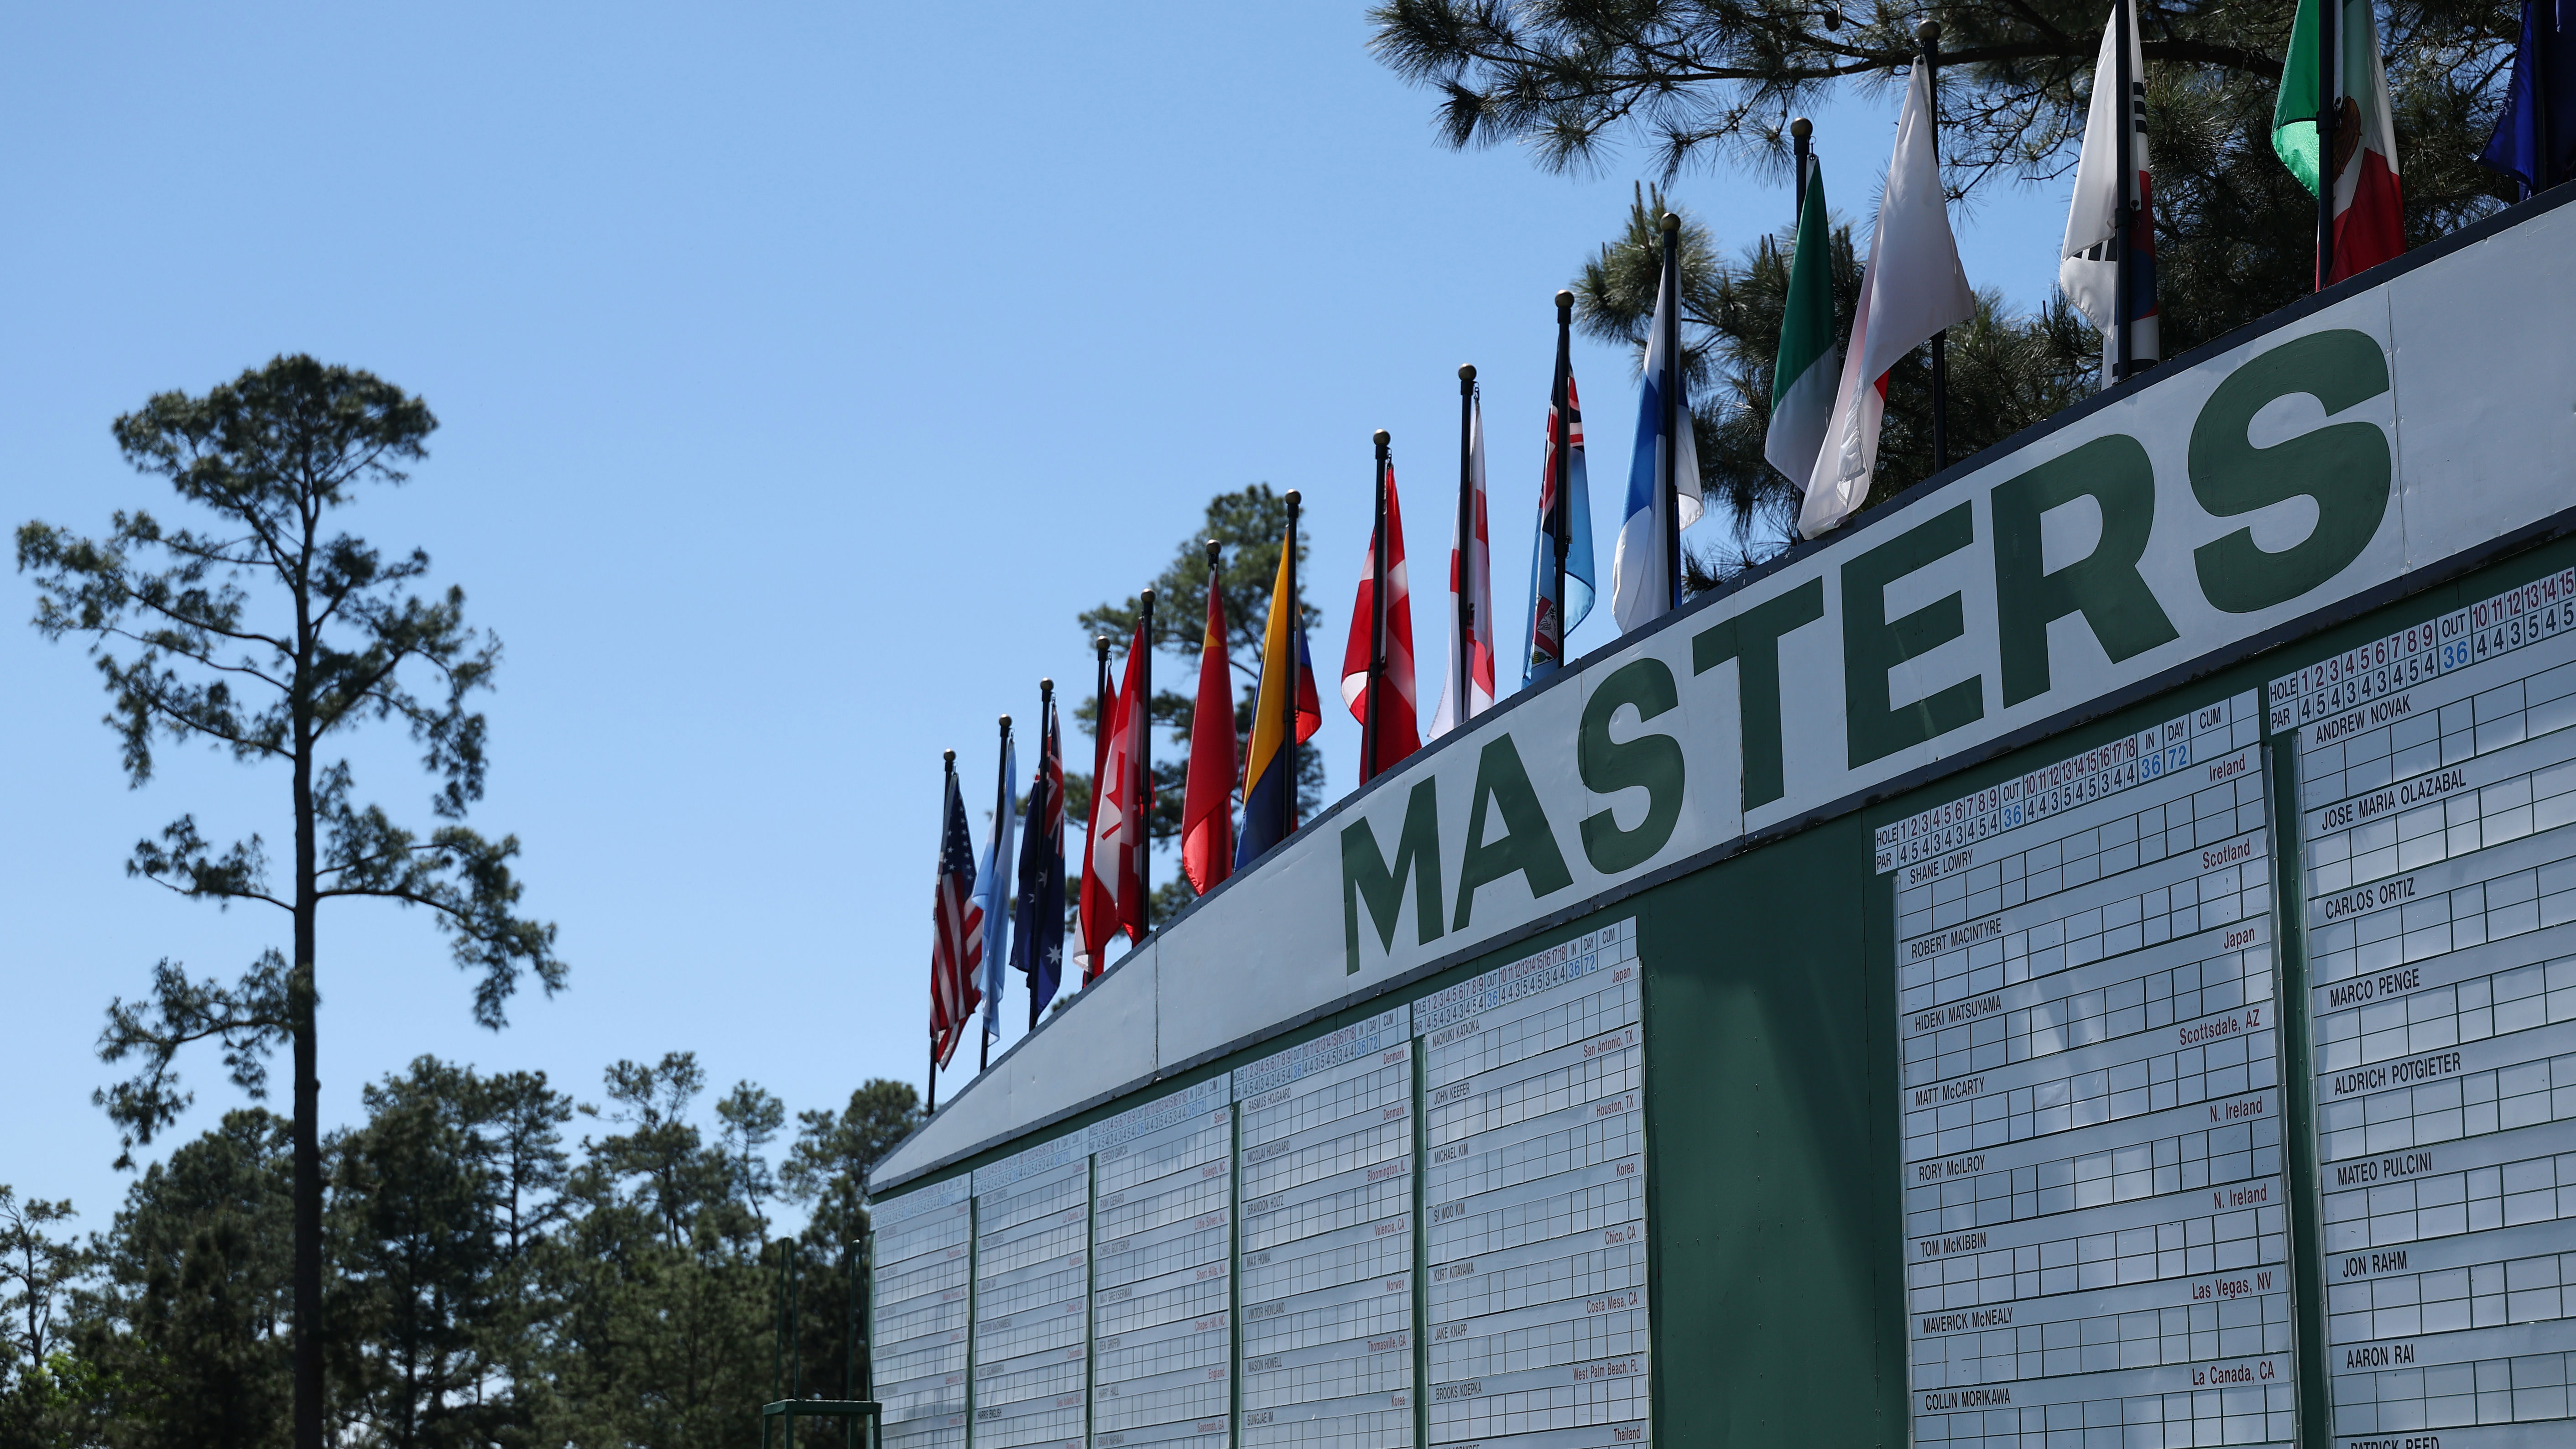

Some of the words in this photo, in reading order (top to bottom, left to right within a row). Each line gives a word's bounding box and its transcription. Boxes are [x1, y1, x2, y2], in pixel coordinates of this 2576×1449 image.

[2270, 678, 2296, 703] HOLE
[2302, 671, 2308, 691] 1
[2315, 666, 2324, 687] 2
[2330, 660, 2338, 681] 3
[2346, 654, 2354, 674] 4
[2361, 647, 2369, 670] 5
[2376, 642, 2385, 664] 6
[2392, 636, 2400, 658] 7
[2408, 631, 2417, 652] 8
[2423, 624, 2432, 646] 9
[2442, 613, 2465, 638] OUT
[2473, 604, 2487, 628] 10
[2492, 598, 2503, 621] 11
[2507, 592, 2521, 616] 12
[2524, 584, 2539, 609] 13
[2542, 578, 2556, 603] 14
[2559, 571, 2574, 596] 15
[1341, 329, 2392, 976] MASTERS
[2271, 708, 2290, 730] PAR
[2302, 698, 2310, 719] 4
[2317, 693, 2325, 714] 5
[2331, 688, 2340, 708] 4
[2347, 682, 2356, 704] 3
[2362, 676, 2371, 697] 4
[2378, 671, 2386, 693] 3
[2393, 664, 2403, 685] 4
[2409, 659, 2418, 681] 5
[2425, 653, 2434, 674] 4
[2444, 641, 2467, 668] 36
[2477, 634, 2487, 656] 4
[2494, 628, 2504, 650] 4
[2511, 622, 2520, 645] 3
[2529, 615, 2539, 638] 5
[2546, 609, 2556, 631] 4
[2564, 602, 2574, 625] 5
[2316, 710, 2364, 744] ANDREW
[2371, 694, 2411, 724] NOVAK
[1877, 827, 1897, 847] HOLE
[2003, 782, 2019, 801] OUT
[2146, 732, 2154, 750] IN
[2168, 720, 2184, 741] DAY
[2200, 707, 2221, 729] CUM
[2210, 753, 2245, 782] Ireland
[1877, 852, 1891, 870] PAR
[2004, 805, 2021, 827] 36
[2142, 755, 2160, 778] 36
[2169, 745, 2186, 769] 72
[2322, 804, 2353, 830] JOSE
[2359, 791, 2395, 818] MARIA
[2401, 769, 2466, 804] OLAZABAL
[2203, 838, 2250, 869] Scotland
[1910, 861, 1939, 884] SHANE
[1943, 849, 1973, 873] LOWRY
[2326, 889, 2373, 919] CARLOS
[2380, 877, 2415, 904] ORTIZ
[1912, 934, 1946, 959] ROBERT
[1951, 917, 2001, 947] MACINTYRE
[2224, 928, 2254, 949] Japan
[1612, 967, 1631, 983] Japan
[2331, 980, 2373, 1007] MARCO
[2379, 968, 2420, 996] PENGE
[1915, 1010, 1944, 1032] HIDEKI
[1949, 995, 2001, 1023] MATSUYAMA
[1433, 1028, 1454, 1048] NAOYUKI
[1456, 1019, 1479, 1038] KATAOKA
[2180, 1016, 2240, 1045] Scottsdale,
[2246, 1009, 2259, 1028] AZ
[1584, 1045, 1595, 1058] San
[1598, 1035, 1622, 1053] Antonio,
[1625, 1029, 1632, 1043] TX
[1384, 1048, 1404, 1064] Denmark
[2335, 1068, 2386, 1095] ALDRICH
[2392, 1052, 2461, 1084] POTGIETER
[1249, 1096, 1266, 1111] RASMUS
[1268, 1088, 1291, 1105] HOJGAARD
[1434, 1090, 1448, 1105] JOHN
[1450, 1082, 1470, 1100] KEEFER
[1916, 1087, 1938, 1106] MATT
[1943, 1077, 1984, 1100] McCARTY
[1383, 1104, 1404, 1121] Denmark
[1596, 1100, 1623, 1117] Houston,
[1626, 1094, 1633, 1108] TX
[2210, 1105, 2220, 1122] N.
[2226, 1096, 2262, 1120] Ireland
[1248, 1148, 1265, 1162] NICOLAI
[1267, 1141, 1289, 1157] HOJGAARD
[1434, 1147, 1456, 1163] MICHAEL
[1459, 1143, 1468, 1157] KIM
[1401, 1160, 1405, 1171] IL
[1617, 1163, 1634, 1177] Korea
[1919, 1162, 1942, 1181] RORY
[1947, 1154, 1985, 1176] McILROY
[2337, 1162, 2377, 1186] MATEO
[2383, 1152, 2431, 1178] PULCINI
[1248, 1200, 1268, 1215] BRANDON
[1271, 1195, 1283, 1208] HOLTZ
[2214, 1192, 2224, 1209] N.
[2230, 1183, 2267, 1206] Ireland
[1434, 1209, 1439, 1222] SI
[1441, 1205, 1454, 1220] WOO
[1455, 1202, 1465, 1215] KIM
[1398, 1218, 1404, 1230] CA
[1605, 1230, 1624, 1245] Chico,
[1627, 1225, 1636, 1240] CA
[1921, 1240, 1939, 1257] TOM
[1944, 1232, 1986, 1254] McKIBBIN
[1247, 1256, 1256, 1267] MAX
[1258, 1252, 1270, 1265] HOMA
[2343, 1256, 2366, 1277] JON
[2373, 1251, 2407, 1273] RAHM
[1434, 1268, 1447, 1282] KURT
[1450, 1261, 1474, 1278] KITAYAMA
[1387, 1279, 1404, 1292] Norway
[2193, 1283, 2211, 1299] Las
[2216, 1279, 2252, 1298] Vegas,
[2258, 1272, 2271, 1290] NV
[1248, 1307, 1263, 1319] VIKTOR
[1265, 1302, 1285, 1316] HOVLAND
[1587, 1299, 1605, 1313] Costa
[1608, 1296, 1626, 1309] Mesa,
[1629, 1291, 1637, 1305] CA
[1435, 1327, 1448, 1340] JAKE
[1450, 1324, 1467, 1338] KNAPP
[1924, 1313, 1968, 1334] MAVERICK
[1972, 1307, 2013, 1328] McNEALY
[1399, 1334, 1406, 1347] GA
[1248, 1360, 1263, 1371] MASON
[1265, 1356, 1282, 1369] HOWELL
[2347, 1347, 2388, 1369] AARON
[2394, 1344, 2414, 1364] RAI
[1573, 1367, 1588, 1381] West
[1591, 1364, 1605, 1378] Palm
[1608, 1360, 1628, 1375] Beach,
[1631, 1359, 1637, 1372] FL
[2192, 1369, 2205, 1385] La
[2210, 1364, 2254, 1384] Canada,
[2260, 1361, 2274, 1380] CA
[1392, 1395, 1405, 1407] Korea
[1436, 1386, 1457, 1400] BROOKS
[1460, 1381, 1482, 1397] KOEPKA
[1926, 1392, 1957, 1411] COLLIN
[1962, 1388, 2010, 1407] MORIKAWA
[1247, 1413, 1267, 1426] SUNGJAE
[1269, 1412, 1273, 1422] IM
[1614, 1425, 1640, 1442] Thailand
